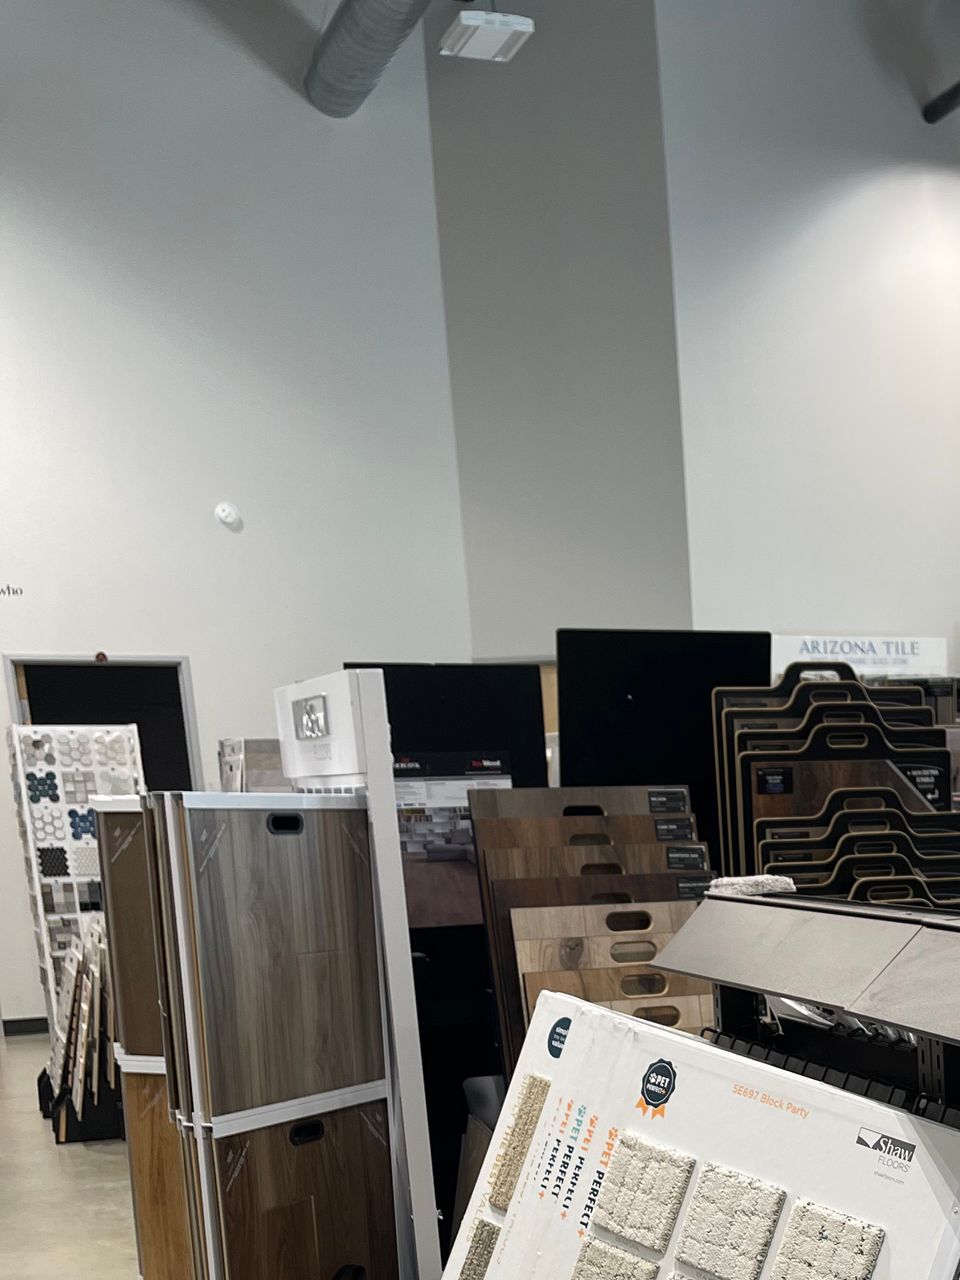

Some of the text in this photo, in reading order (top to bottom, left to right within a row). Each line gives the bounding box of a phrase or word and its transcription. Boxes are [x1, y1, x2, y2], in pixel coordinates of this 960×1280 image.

[800, 640, 920, 656] ARIZONA TILE
[656, 1074, 670, 1088] PET
[760, 1093, 785, 1110] Block
[786, 1102, 811, 1119] Party
[551, 1116, 583, 1198] PET PERFECT
[600, 1141, 615, 1168] PET
[876, 1137, 913, 1162] Shaw
[487, 1153, 505, 1187] BEST
[878, 1154, 911, 1173] FLOORS
